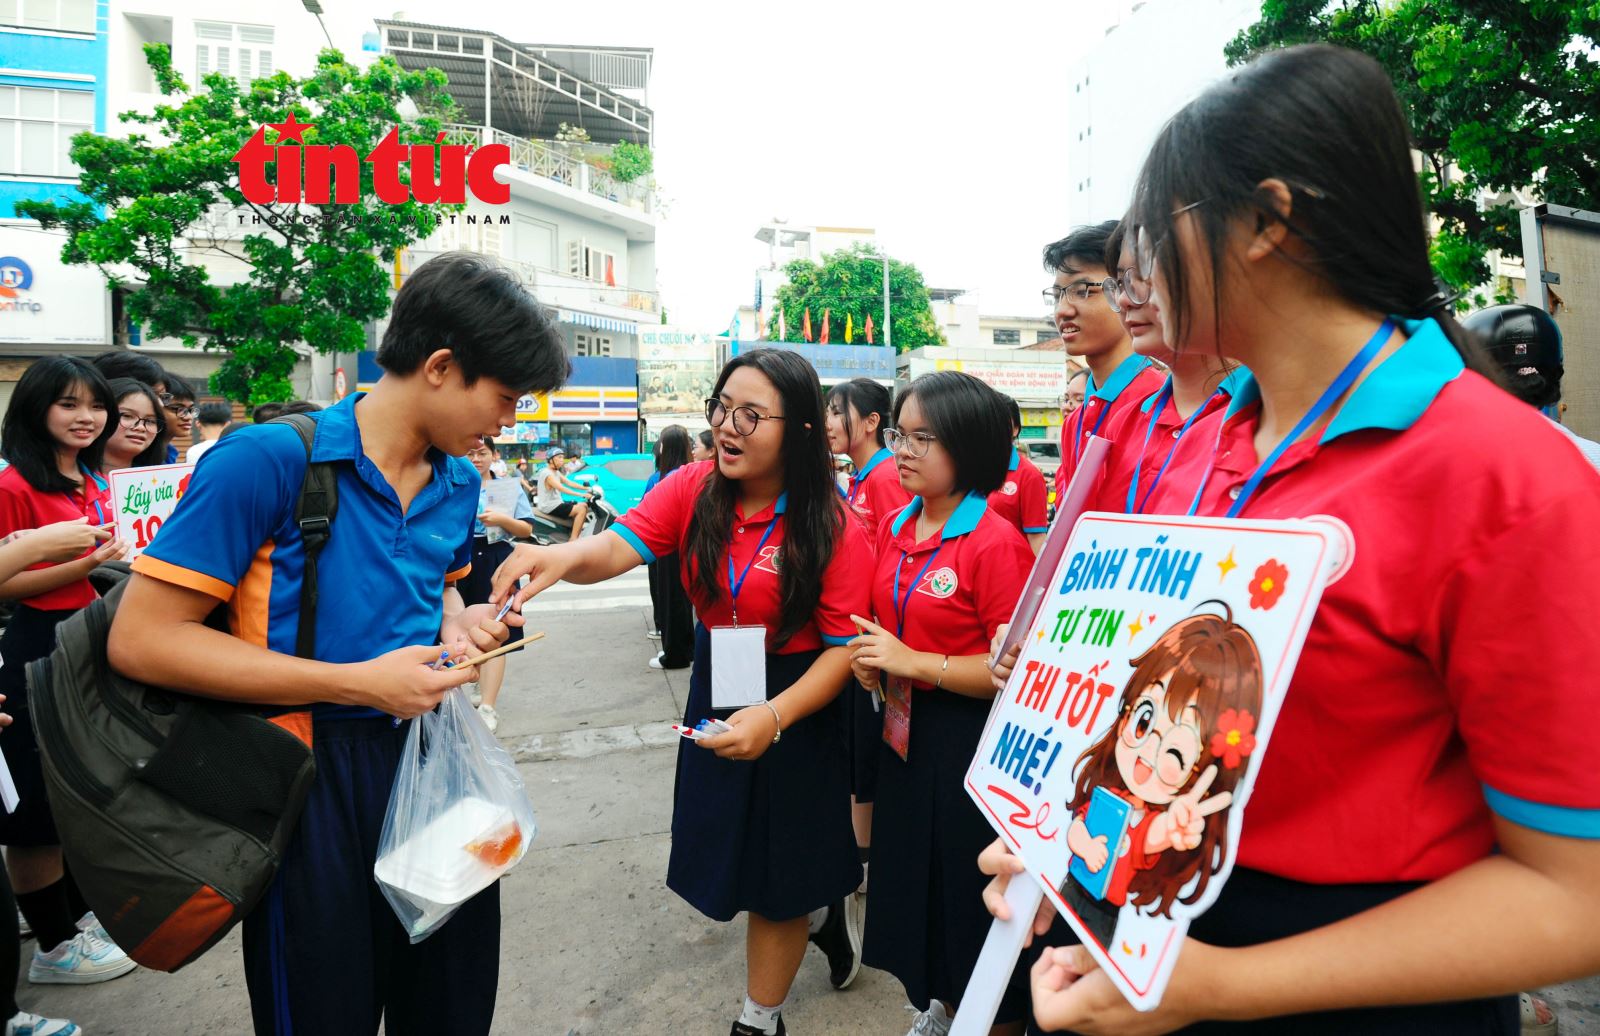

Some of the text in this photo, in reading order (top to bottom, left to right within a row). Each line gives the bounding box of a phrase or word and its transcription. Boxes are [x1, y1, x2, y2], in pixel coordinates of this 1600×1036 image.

[122, 480, 173, 515] Lấy vía
[1060, 534, 1202, 600] BÌNH TĨNH
[1050, 605, 1124, 653] TỰ TIN
[1015, 660, 1115, 735] THI TỐT
[990, 721, 1062, 796] NHÉ!
